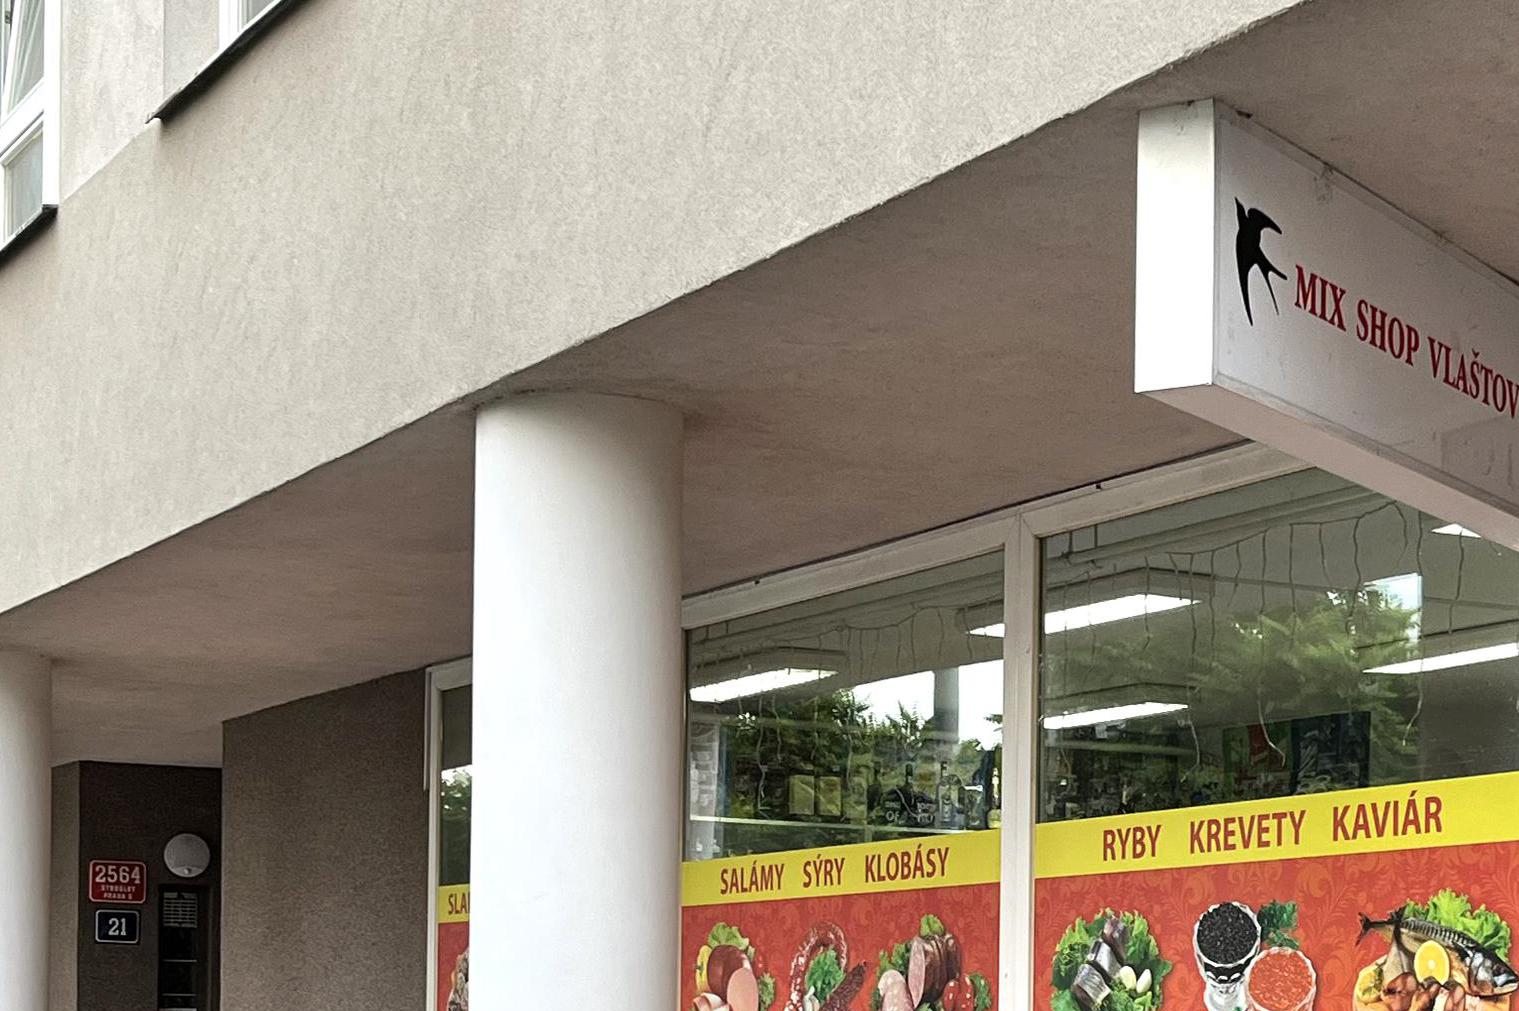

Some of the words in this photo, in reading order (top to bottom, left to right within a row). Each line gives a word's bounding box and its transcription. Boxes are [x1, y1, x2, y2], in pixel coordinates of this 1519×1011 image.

[1295, 264, 1347, 332] MIX
[1356, 299, 1420, 366] SHOP
[1102, 825, 1162, 861] RYBY
[1190, 810, 1306, 854] KREVETY
[1333, 790, 1442, 841] KAVIÁR
[95, 865, 140, 884] 2564
[720, 860, 784, 894] SALÁMY
[803, 854, 845, 888] SÝRY
[865, 844, 949, 883] KLOBÁSY
[108, 918, 126, 936] 21
